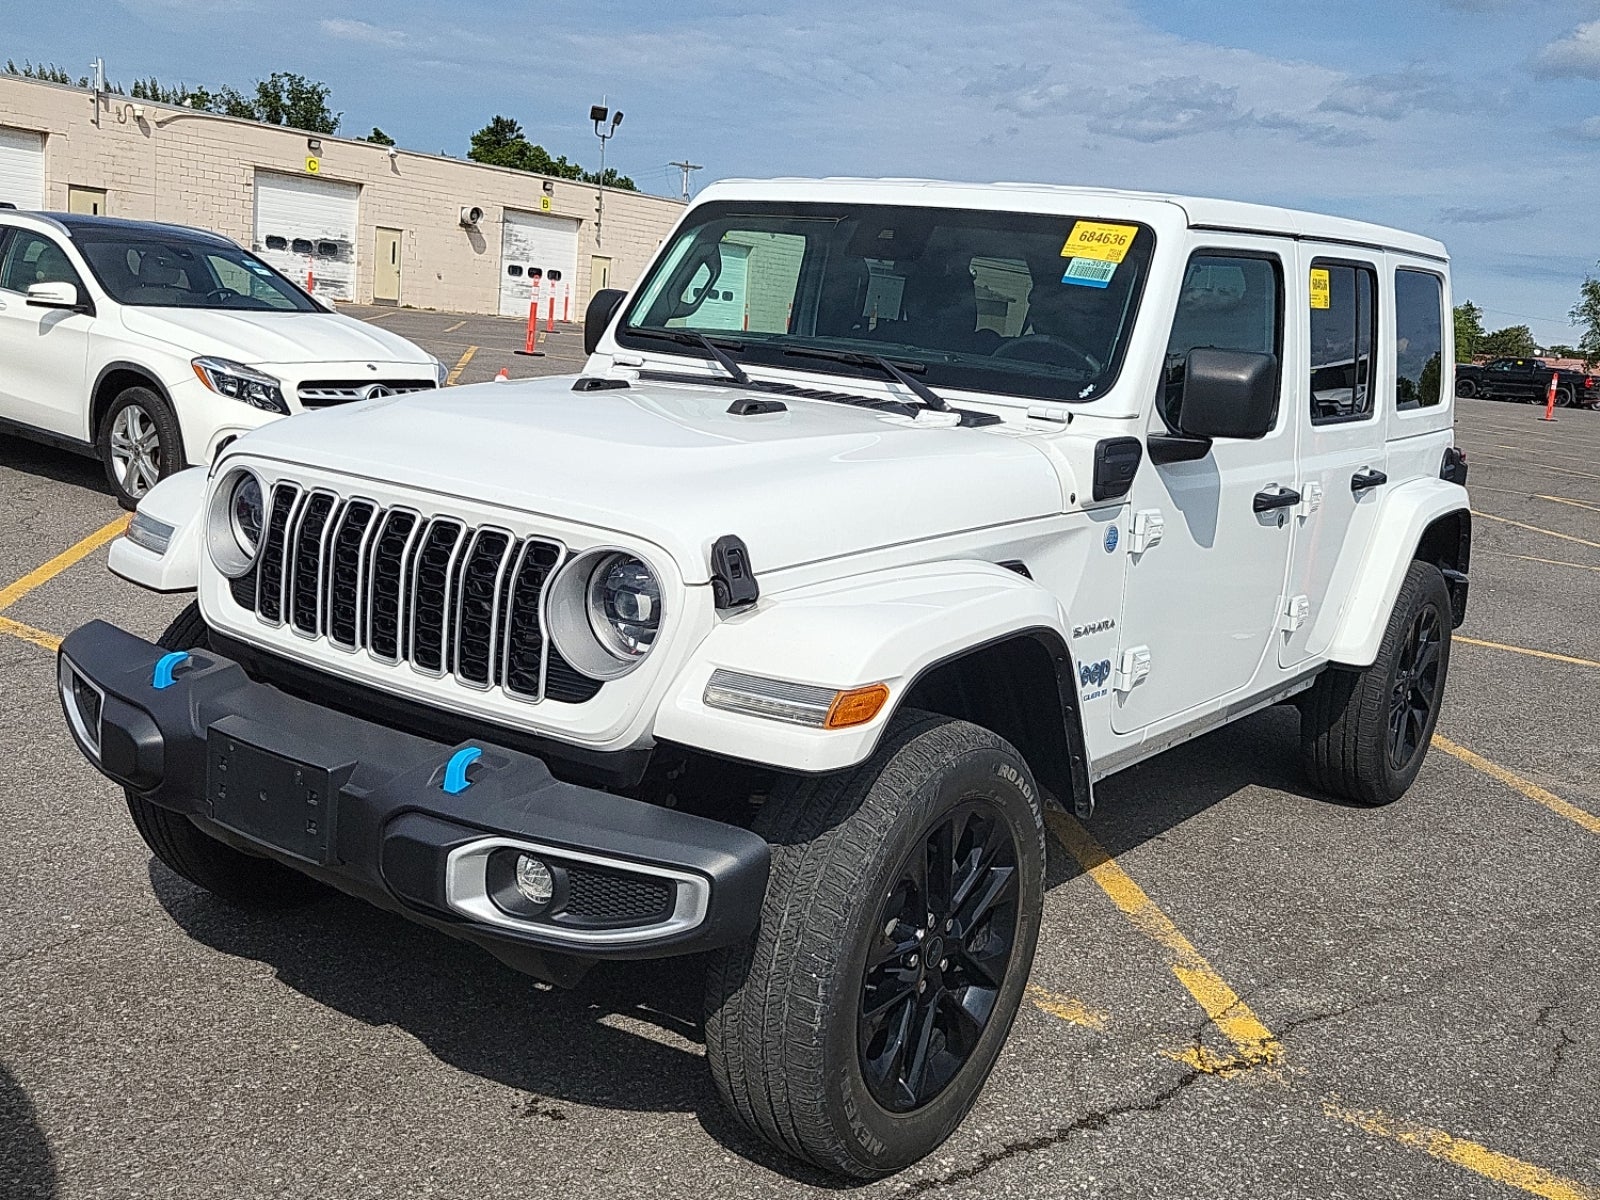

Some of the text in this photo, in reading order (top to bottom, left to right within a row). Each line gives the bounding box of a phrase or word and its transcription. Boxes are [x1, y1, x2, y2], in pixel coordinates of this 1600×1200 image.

[308, 159, 317, 171] C
[542, 198, 549, 209] B
[1079, 230, 1127, 246] 684636
[1073, 619, 1116, 639] SAHARA
[996, 765, 1043, 829] ROADIAN
